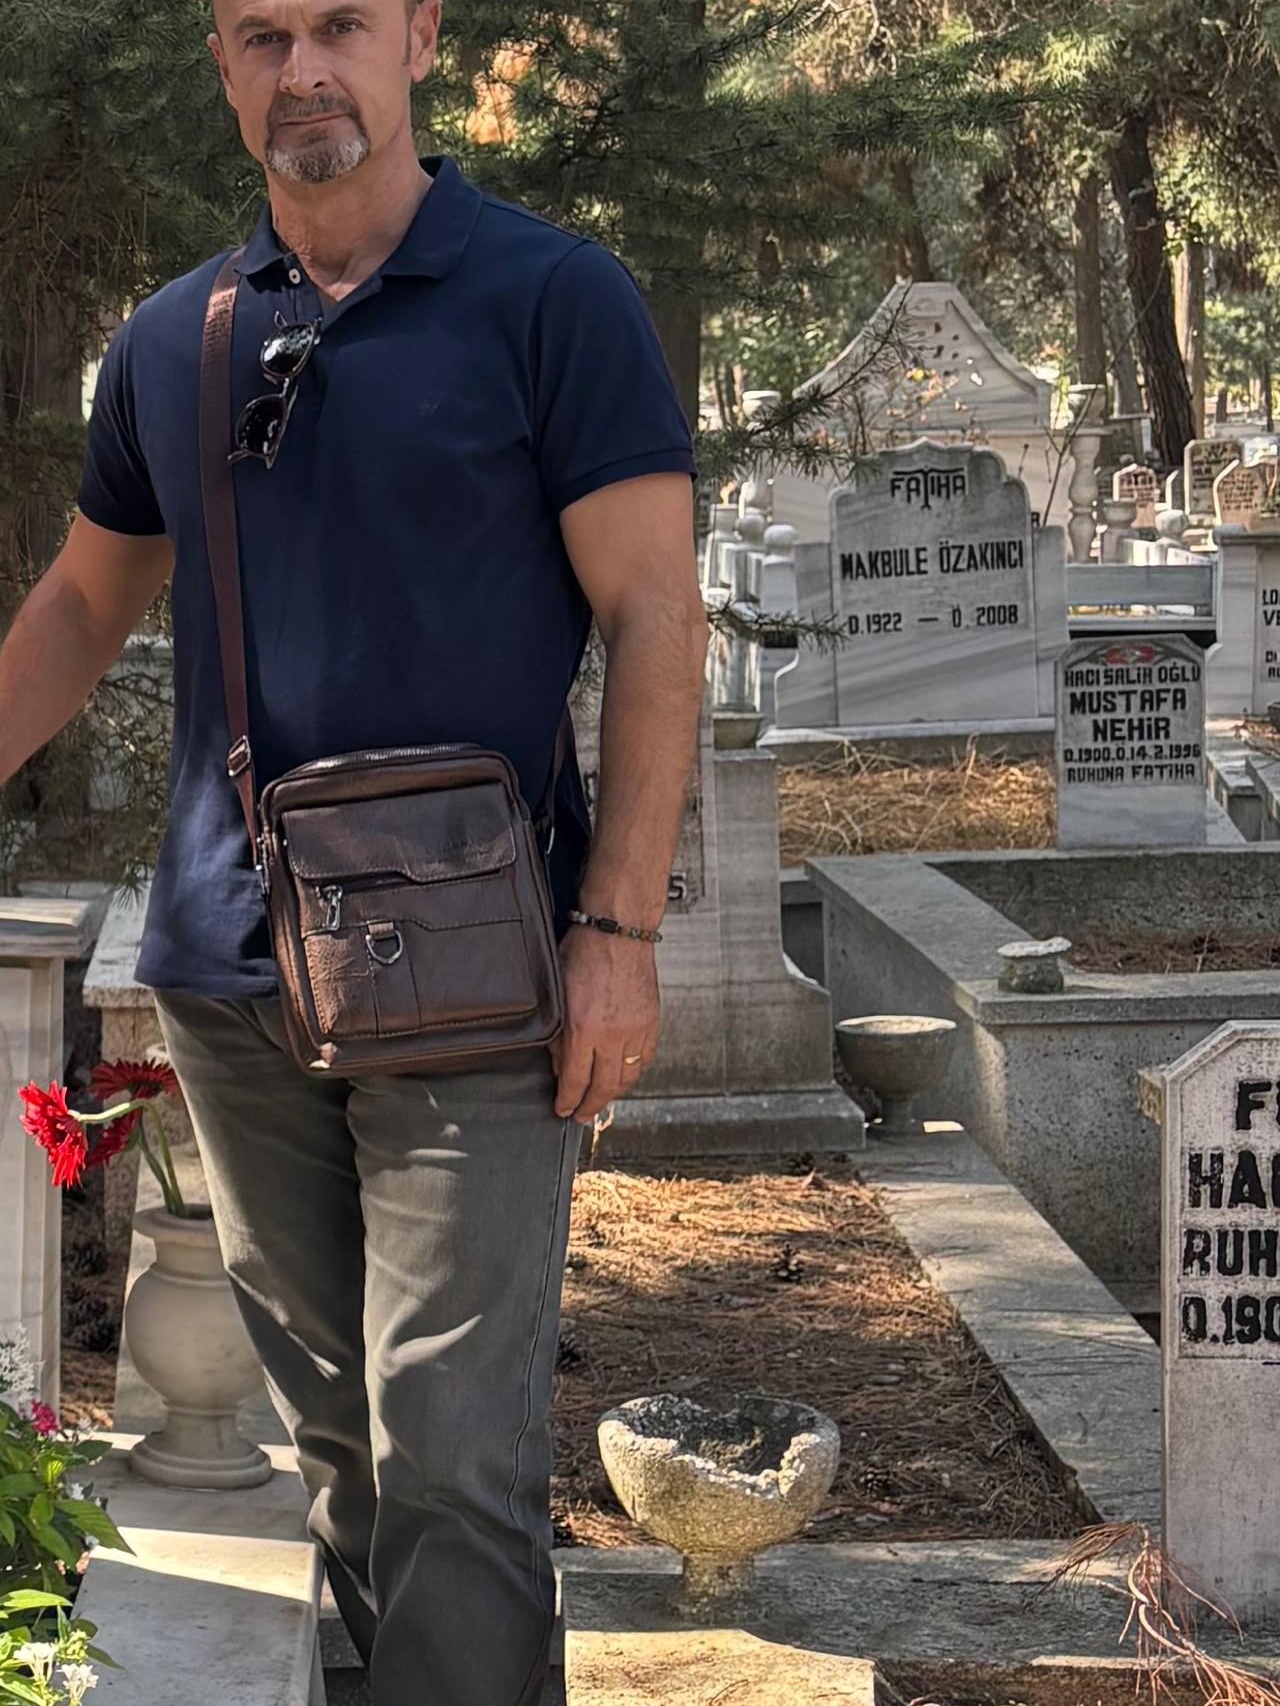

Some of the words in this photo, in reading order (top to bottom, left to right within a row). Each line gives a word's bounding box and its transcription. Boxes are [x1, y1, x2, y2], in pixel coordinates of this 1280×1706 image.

[840, 546, 928, 581] MAKBULE
[938, 539, 1024, 574] ÖZAKINCI
[848, 612, 902, 635] D.1922
[976, 604, 1019, 627] 2008
[1064, 669, 1100, 687] HACI
[1070, 688, 1186, 715] MUSTAFA
[1067, 766, 1124, 783] RUHUNA
